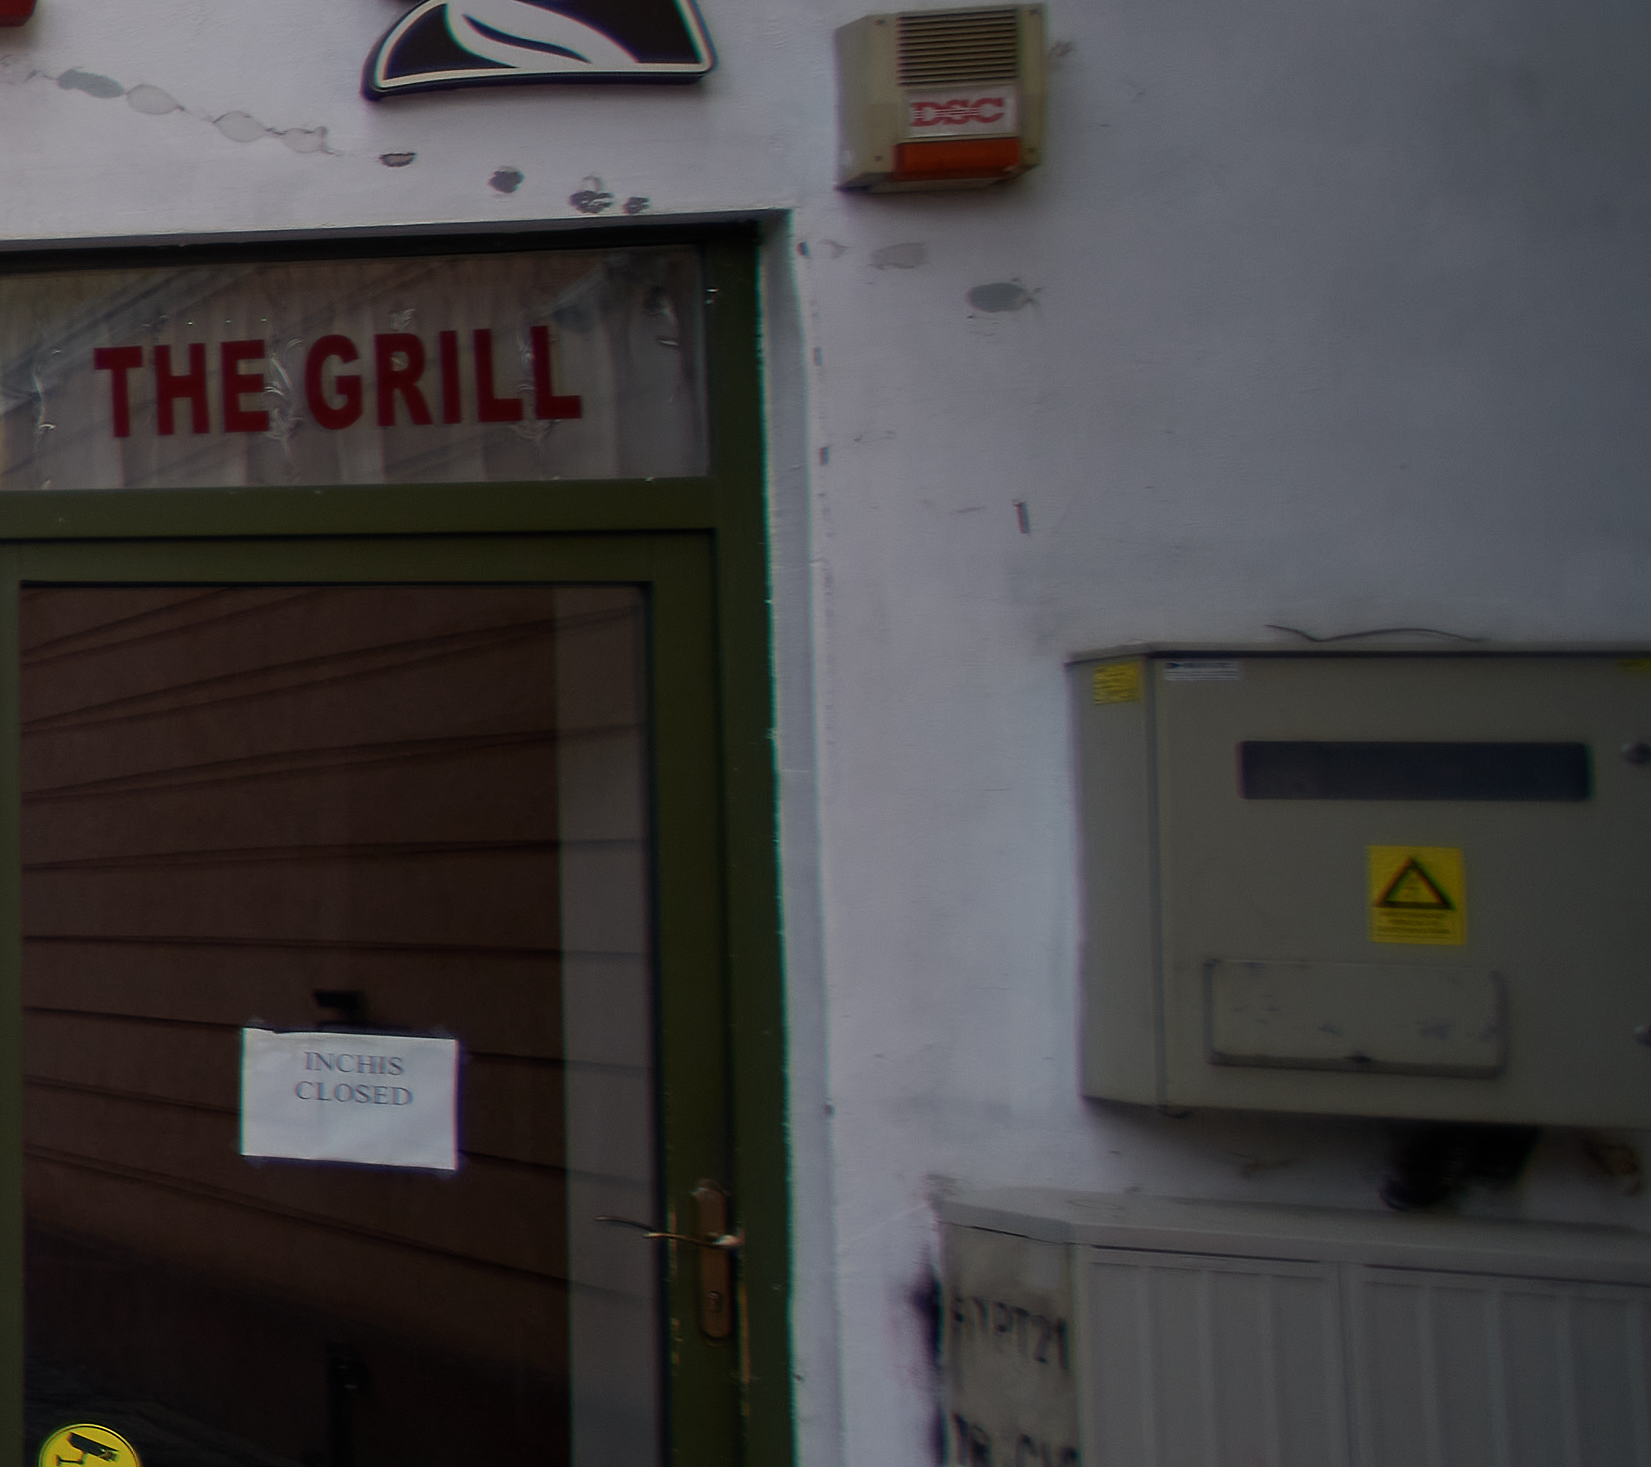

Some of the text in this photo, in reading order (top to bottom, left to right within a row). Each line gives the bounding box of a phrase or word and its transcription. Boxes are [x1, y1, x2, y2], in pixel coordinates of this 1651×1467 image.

[909, 98, 1005, 127] DSC
[94, 325, 582, 438] THE GRILL
[304, 1052, 405, 1076] INCHIS
[294, 1081, 414, 1106] CLOSED
